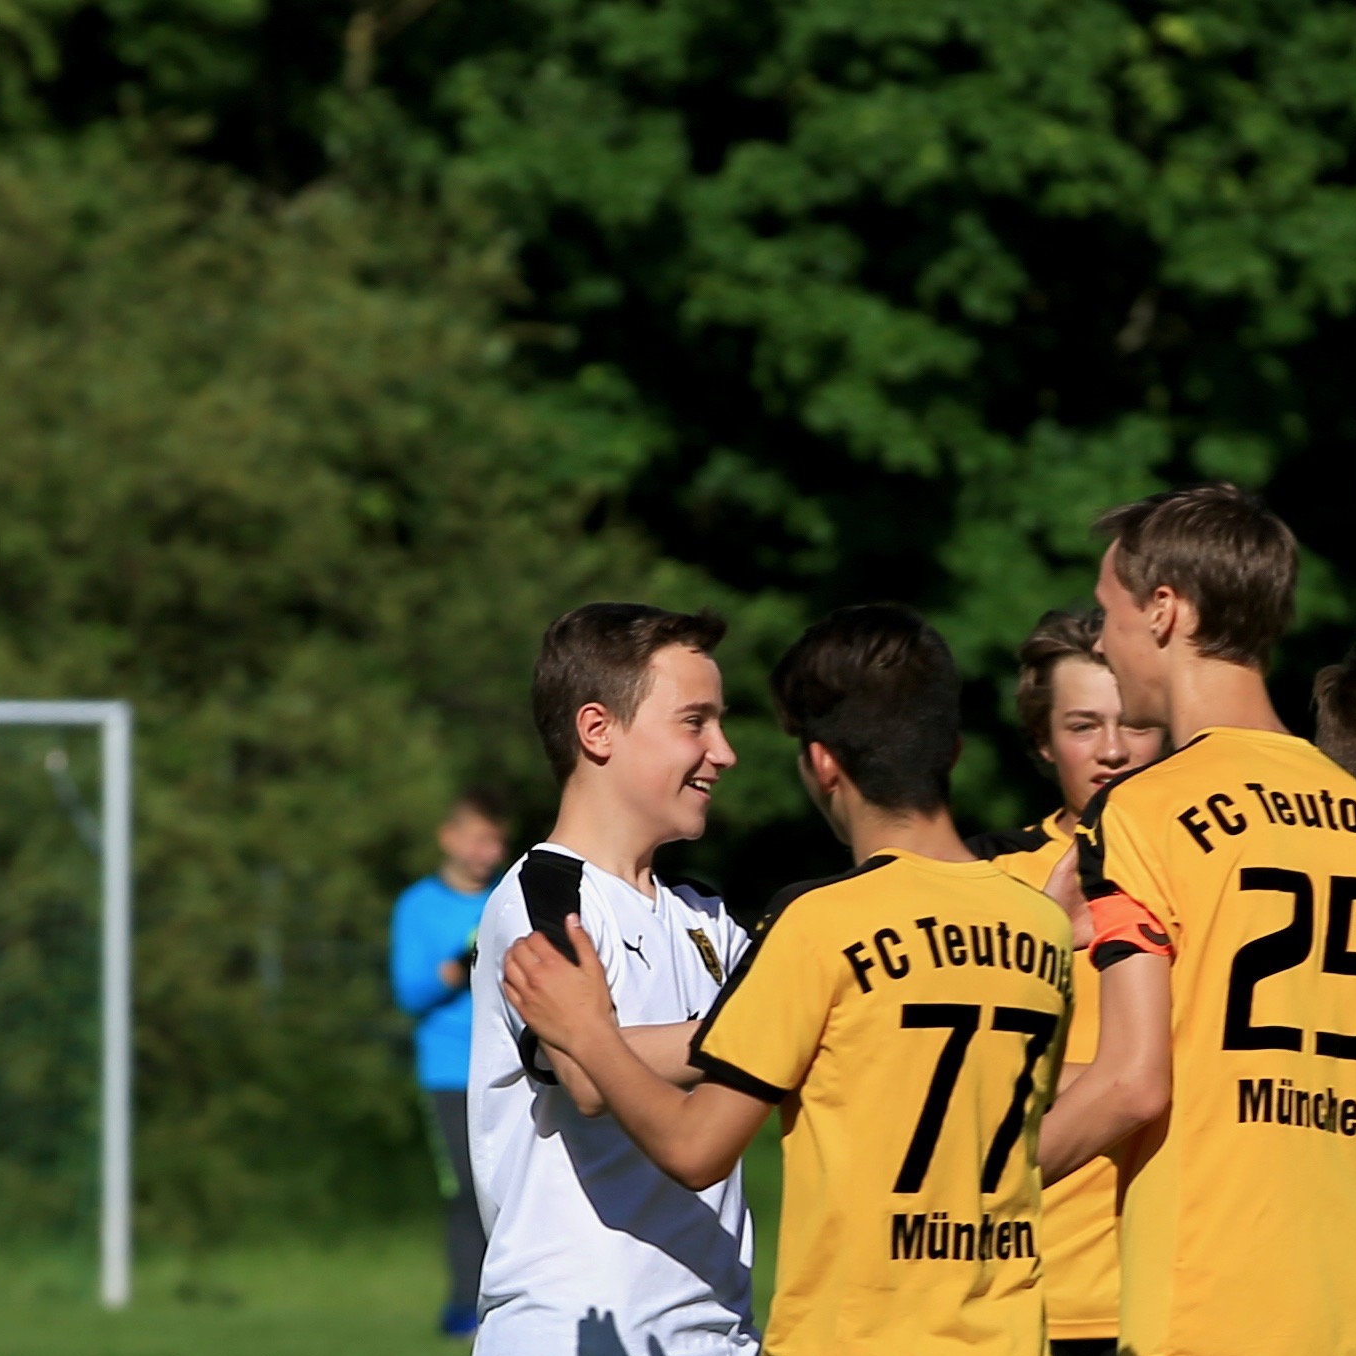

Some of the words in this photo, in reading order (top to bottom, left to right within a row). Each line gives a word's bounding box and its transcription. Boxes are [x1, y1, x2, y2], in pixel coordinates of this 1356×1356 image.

[1177, 793, 1247, 854] FC
[842, 927, 910, 994] FC
[892, 1003, 1058, 1194] 77
